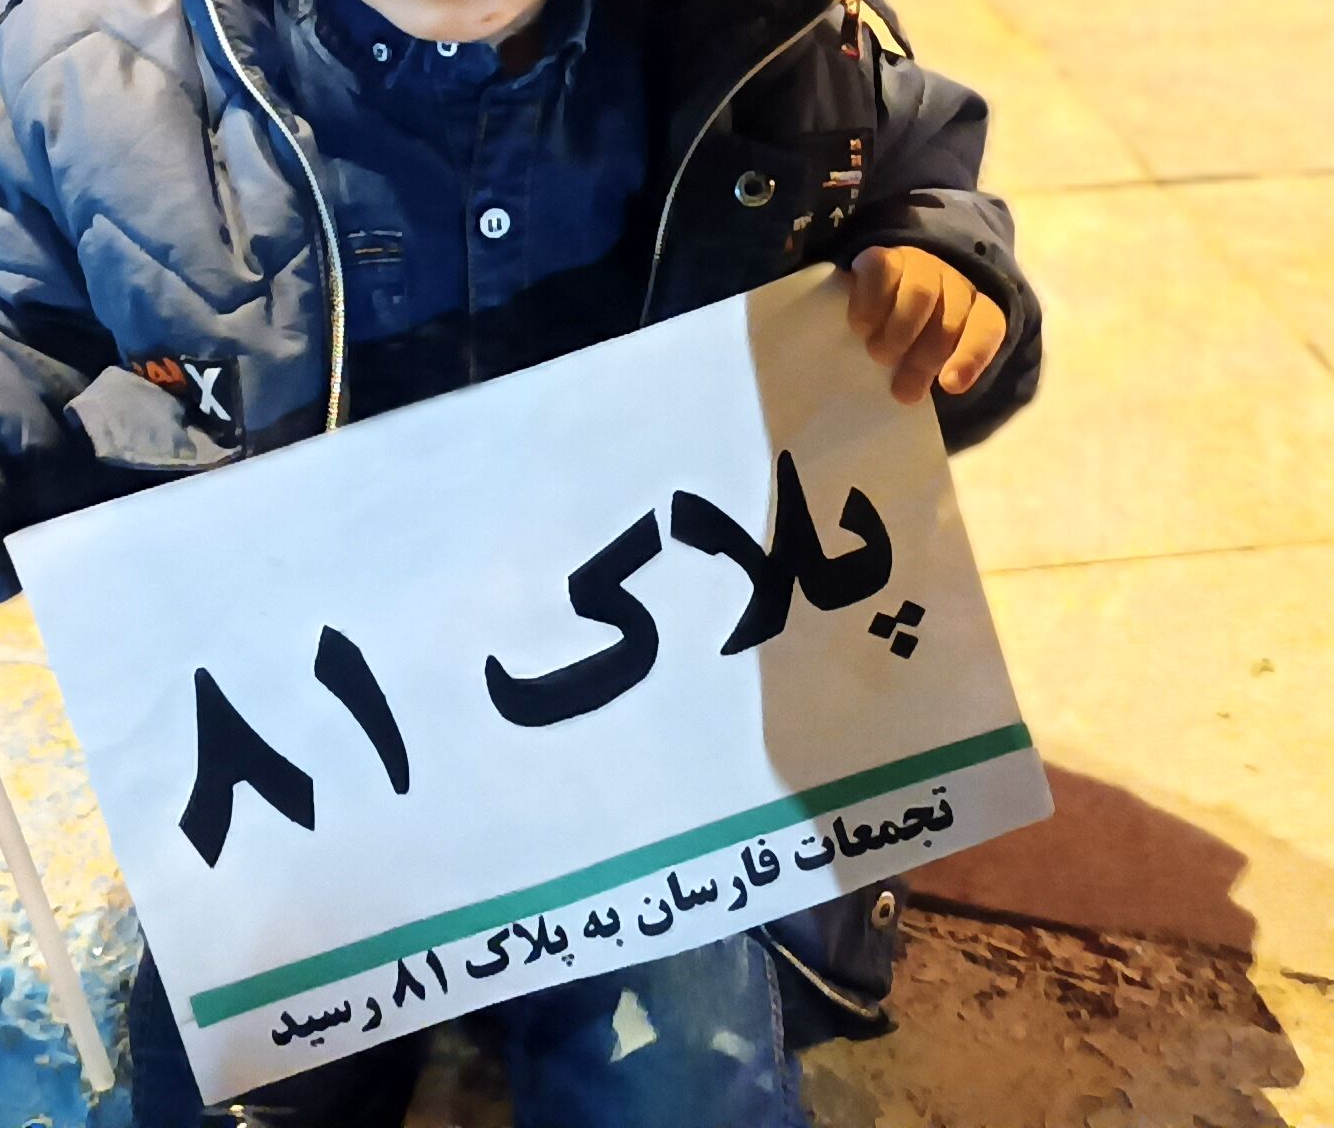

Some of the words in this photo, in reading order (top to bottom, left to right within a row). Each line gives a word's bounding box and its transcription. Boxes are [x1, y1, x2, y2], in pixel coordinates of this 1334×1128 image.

[483, 449, 926, 729] پلاک
[178, 625, 411, 868] ۸۱
[793, 785, 954, 871] تجمعات
[637, 837, 781, 937] فارسان
[465, 914, 575, 979] پلاک
[582, 906, 623, 947] به
[392, 948, 449, 1008] ۸۱
[271, 998, 383, 1047] رسید
